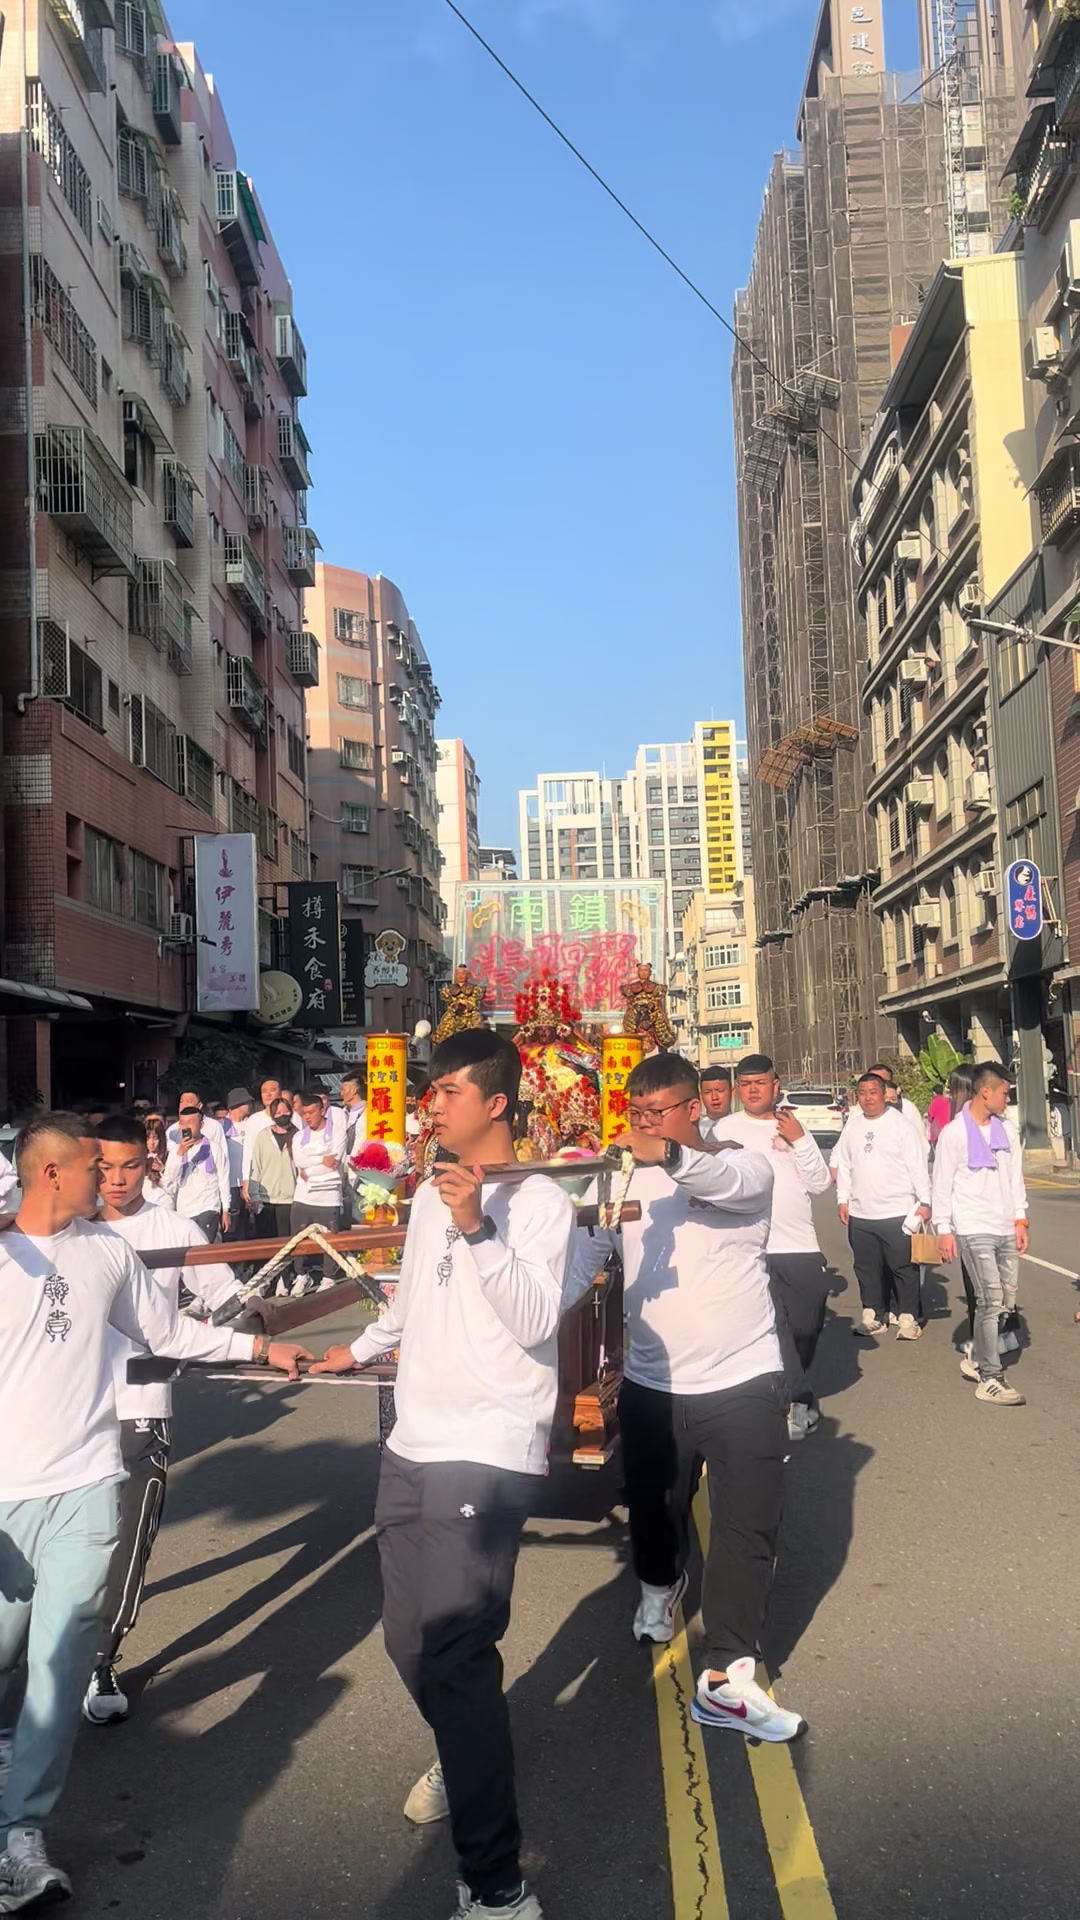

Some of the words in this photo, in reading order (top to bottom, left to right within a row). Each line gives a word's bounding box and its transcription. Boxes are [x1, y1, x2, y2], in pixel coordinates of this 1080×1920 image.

[215, 885, 236, 957] 伊麗秀
[301, 895, 327, 1011] 樽禾食府
